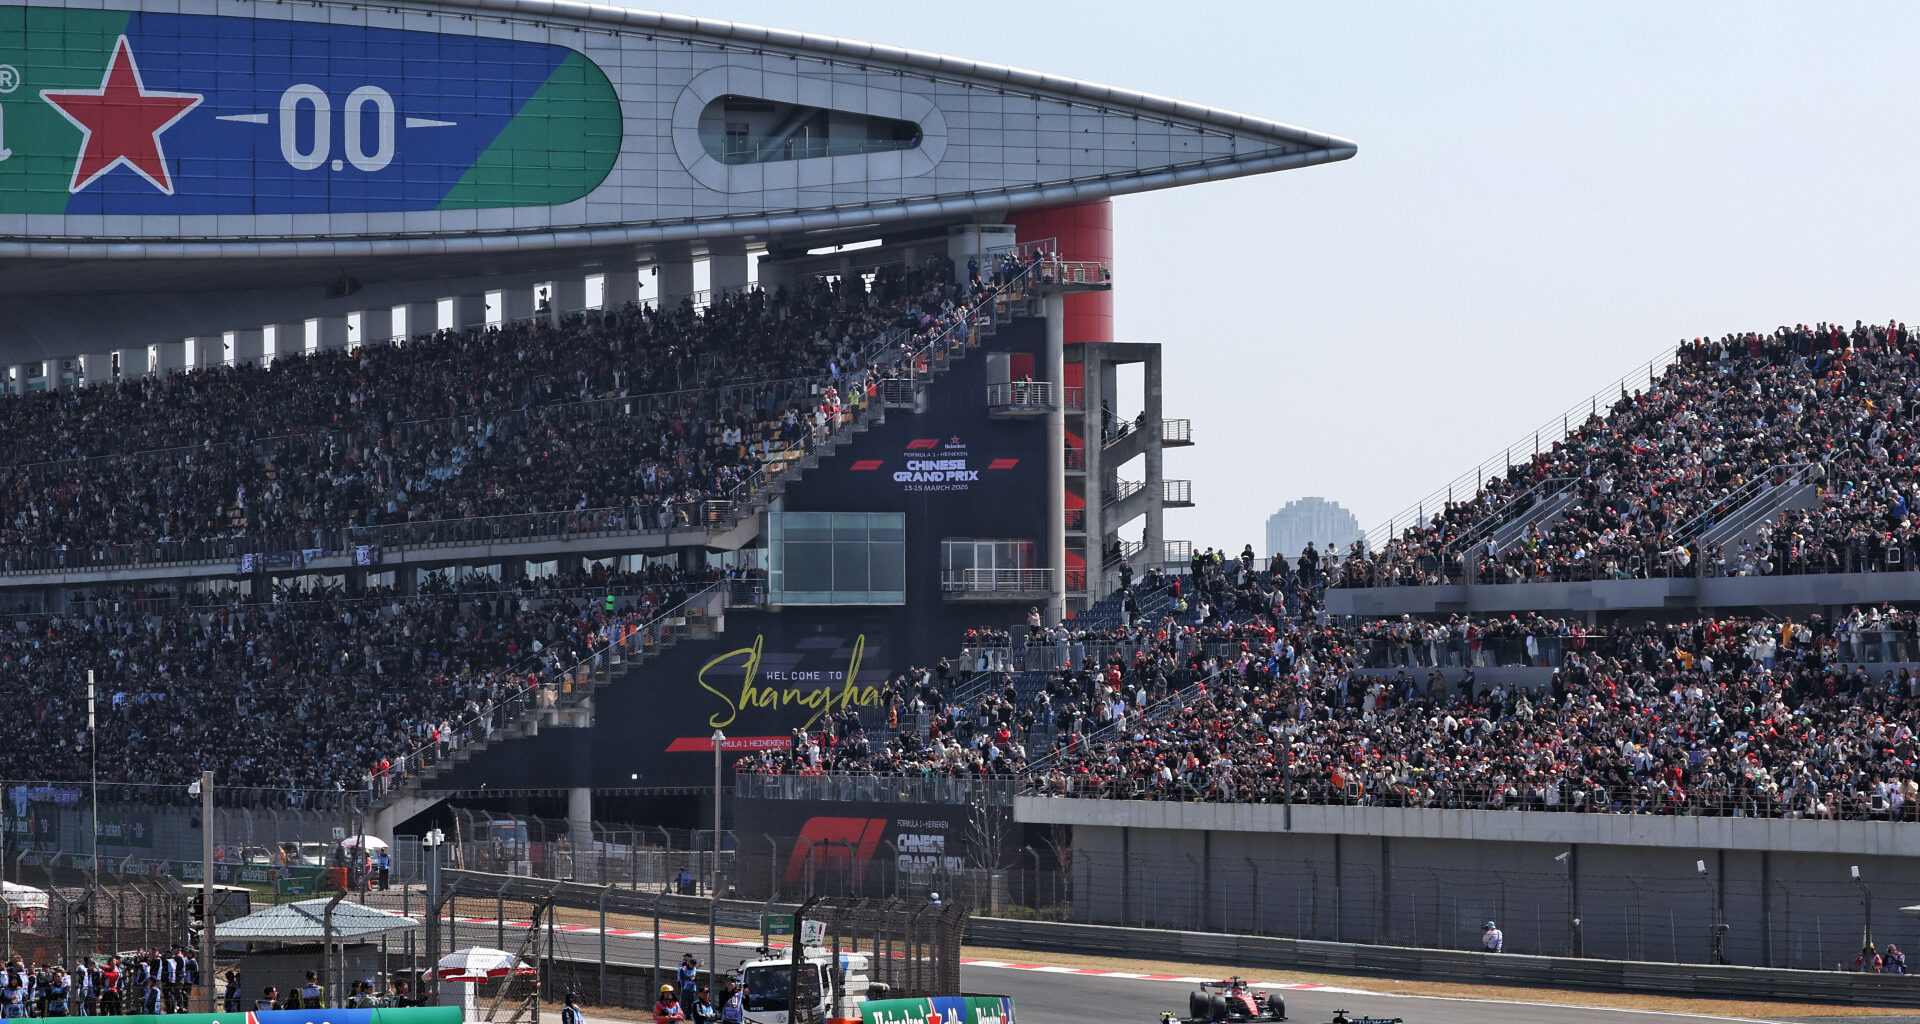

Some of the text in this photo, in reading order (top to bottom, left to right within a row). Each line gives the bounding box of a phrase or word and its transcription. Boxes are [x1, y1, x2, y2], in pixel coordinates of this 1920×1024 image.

[279, 83, 395, 172] 0.0
[906, 459, 966, 471] CHINESE
[893, 470, 979, 482] GRAND PRIX
[766, 671, 842, 680] WELCOME TO
[749, 739, 784, 747] HEINEKEN
[897, 819, 919, 828] FORMULA
[925, 820, 949, 829] HEINEKEN
[897, 833, 945, 853] CHINESE
